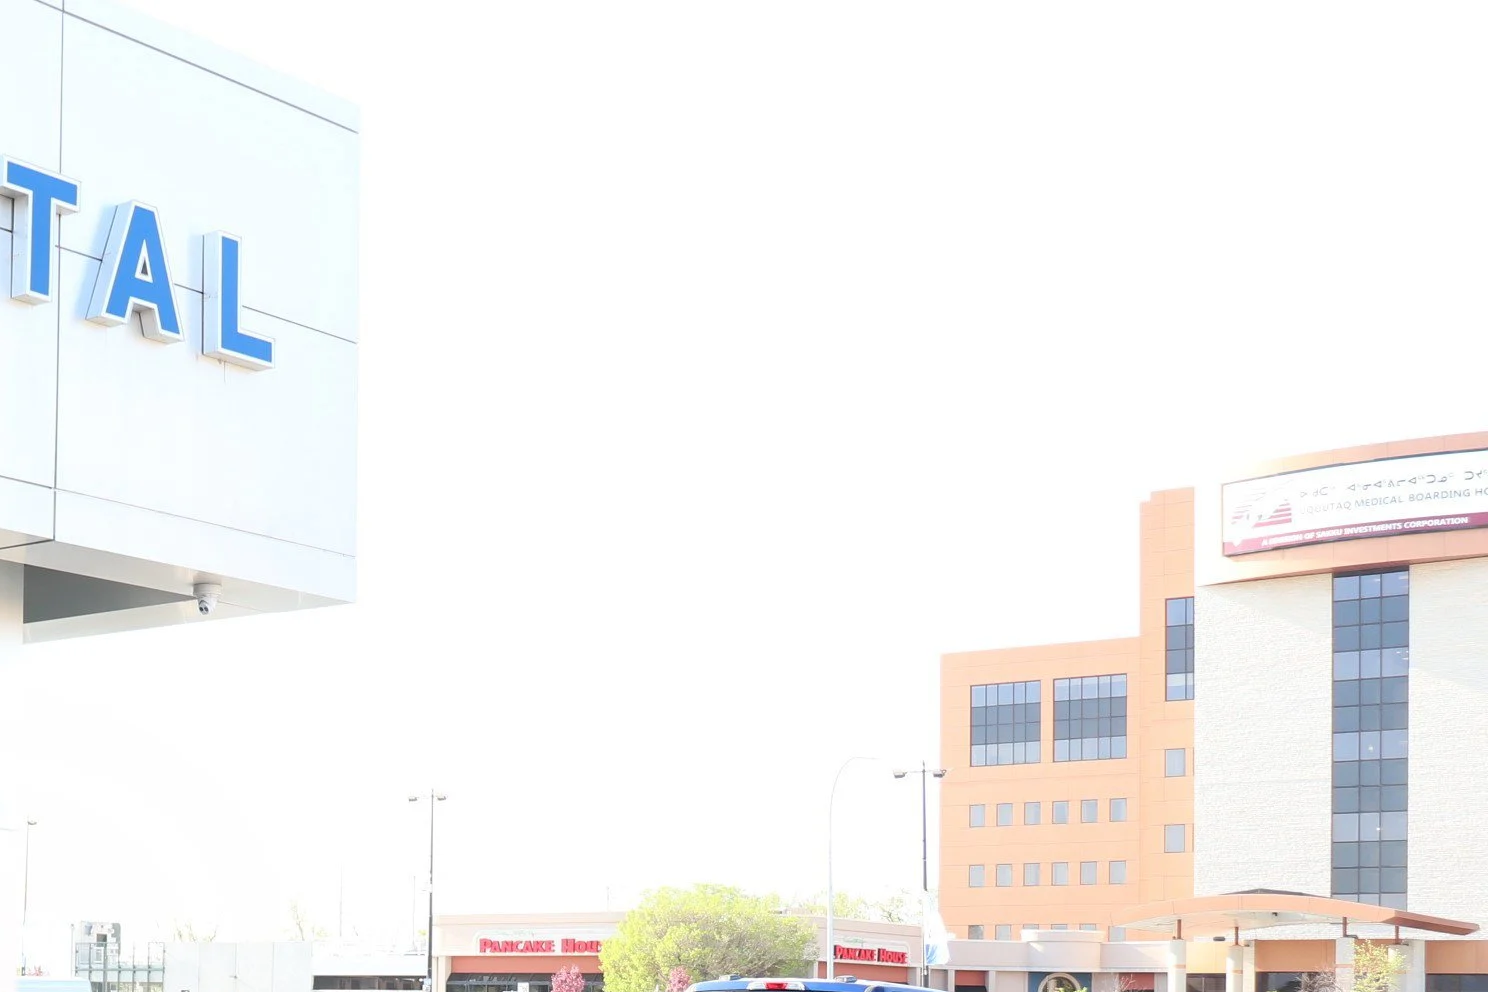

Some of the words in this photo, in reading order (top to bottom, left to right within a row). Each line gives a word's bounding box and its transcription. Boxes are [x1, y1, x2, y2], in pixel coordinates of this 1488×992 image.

[1354, 495, 1404, 508] MEDICAL
[1408, 488, 1471, 502] BOARDING
[1304, 531, 1315, 540] OF
[1343, 522, 1403, 535] INVESTMENTS
[1403, 516, 1469, 529] CORPORATION
[479, 937, 556, 953] PANCAKE
[561, 938, 603, 953] HOU
[834, 944, 876, 961] PANCAKE
[877, 948, 909, 964] HOUSE
